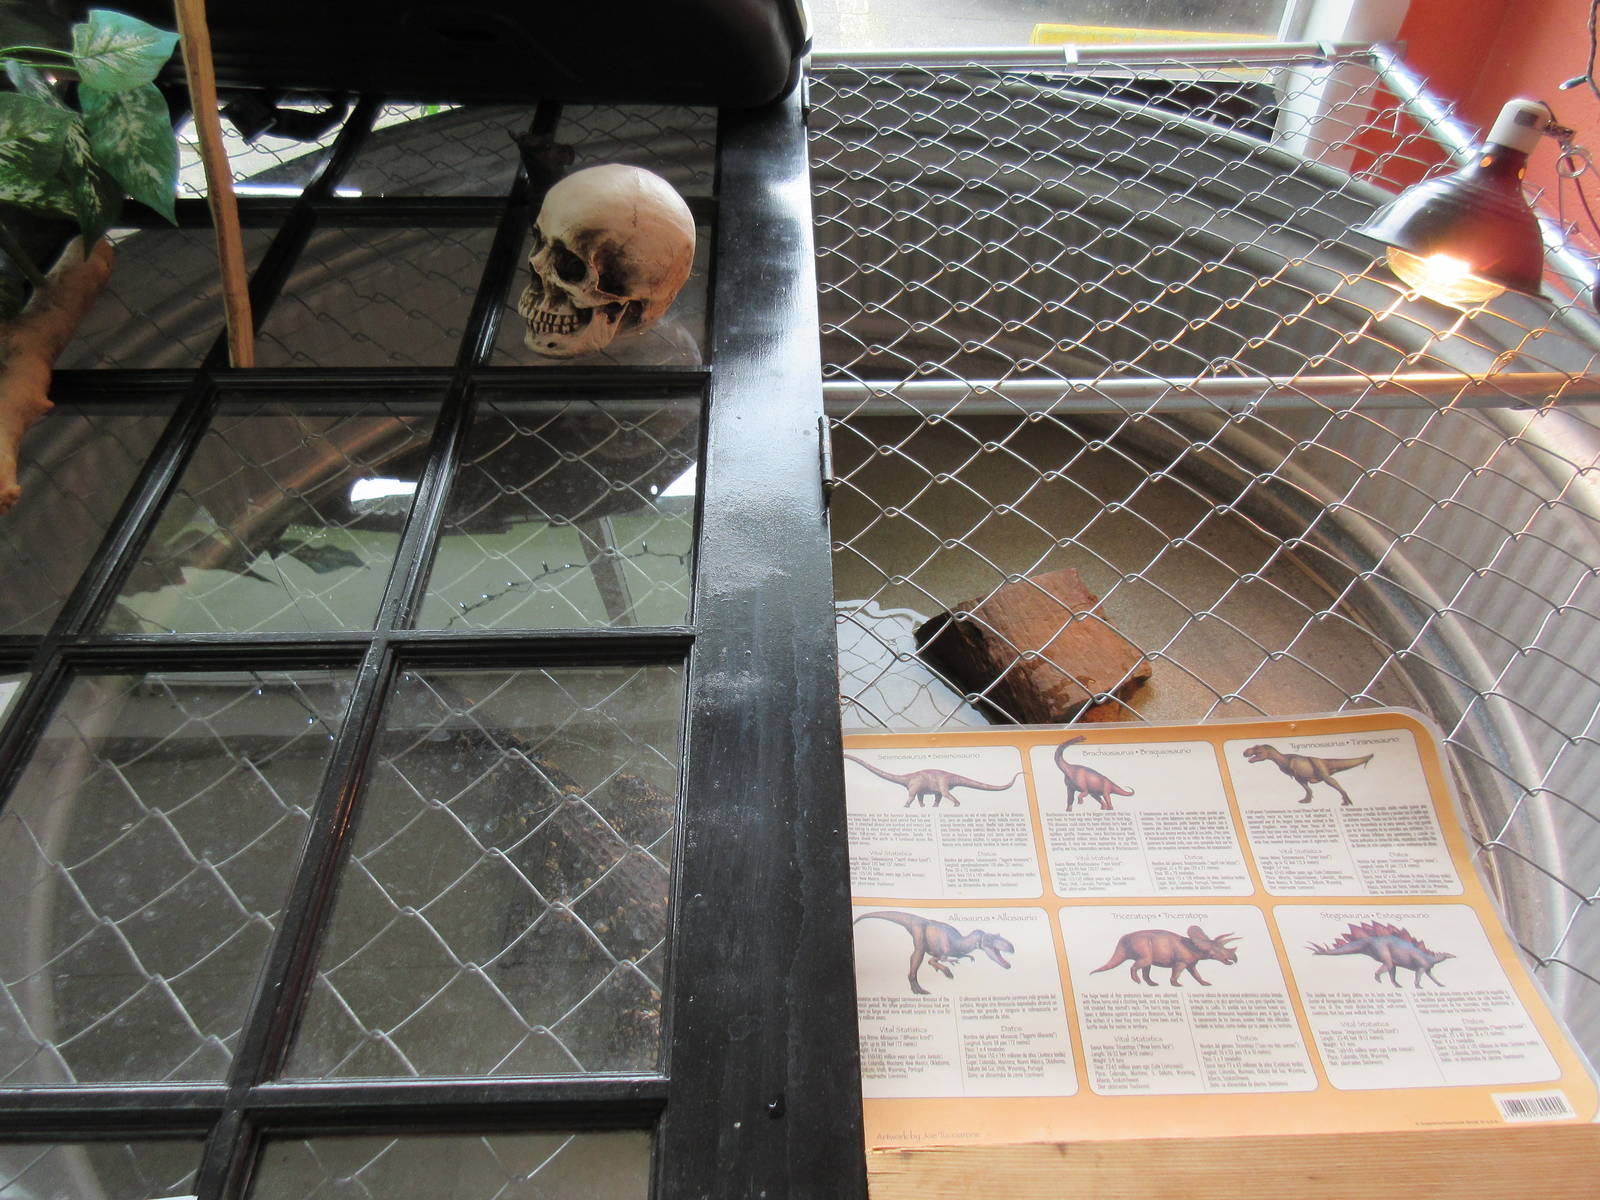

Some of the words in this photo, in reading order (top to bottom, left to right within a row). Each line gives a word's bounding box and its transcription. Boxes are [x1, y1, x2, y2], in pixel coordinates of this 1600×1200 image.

[1290, 742, 1345, 751] Tyrannosaurus
[1112, 912, 1156, 921] Triceratops
[1164, 912, 1208, 921] Triceratops
